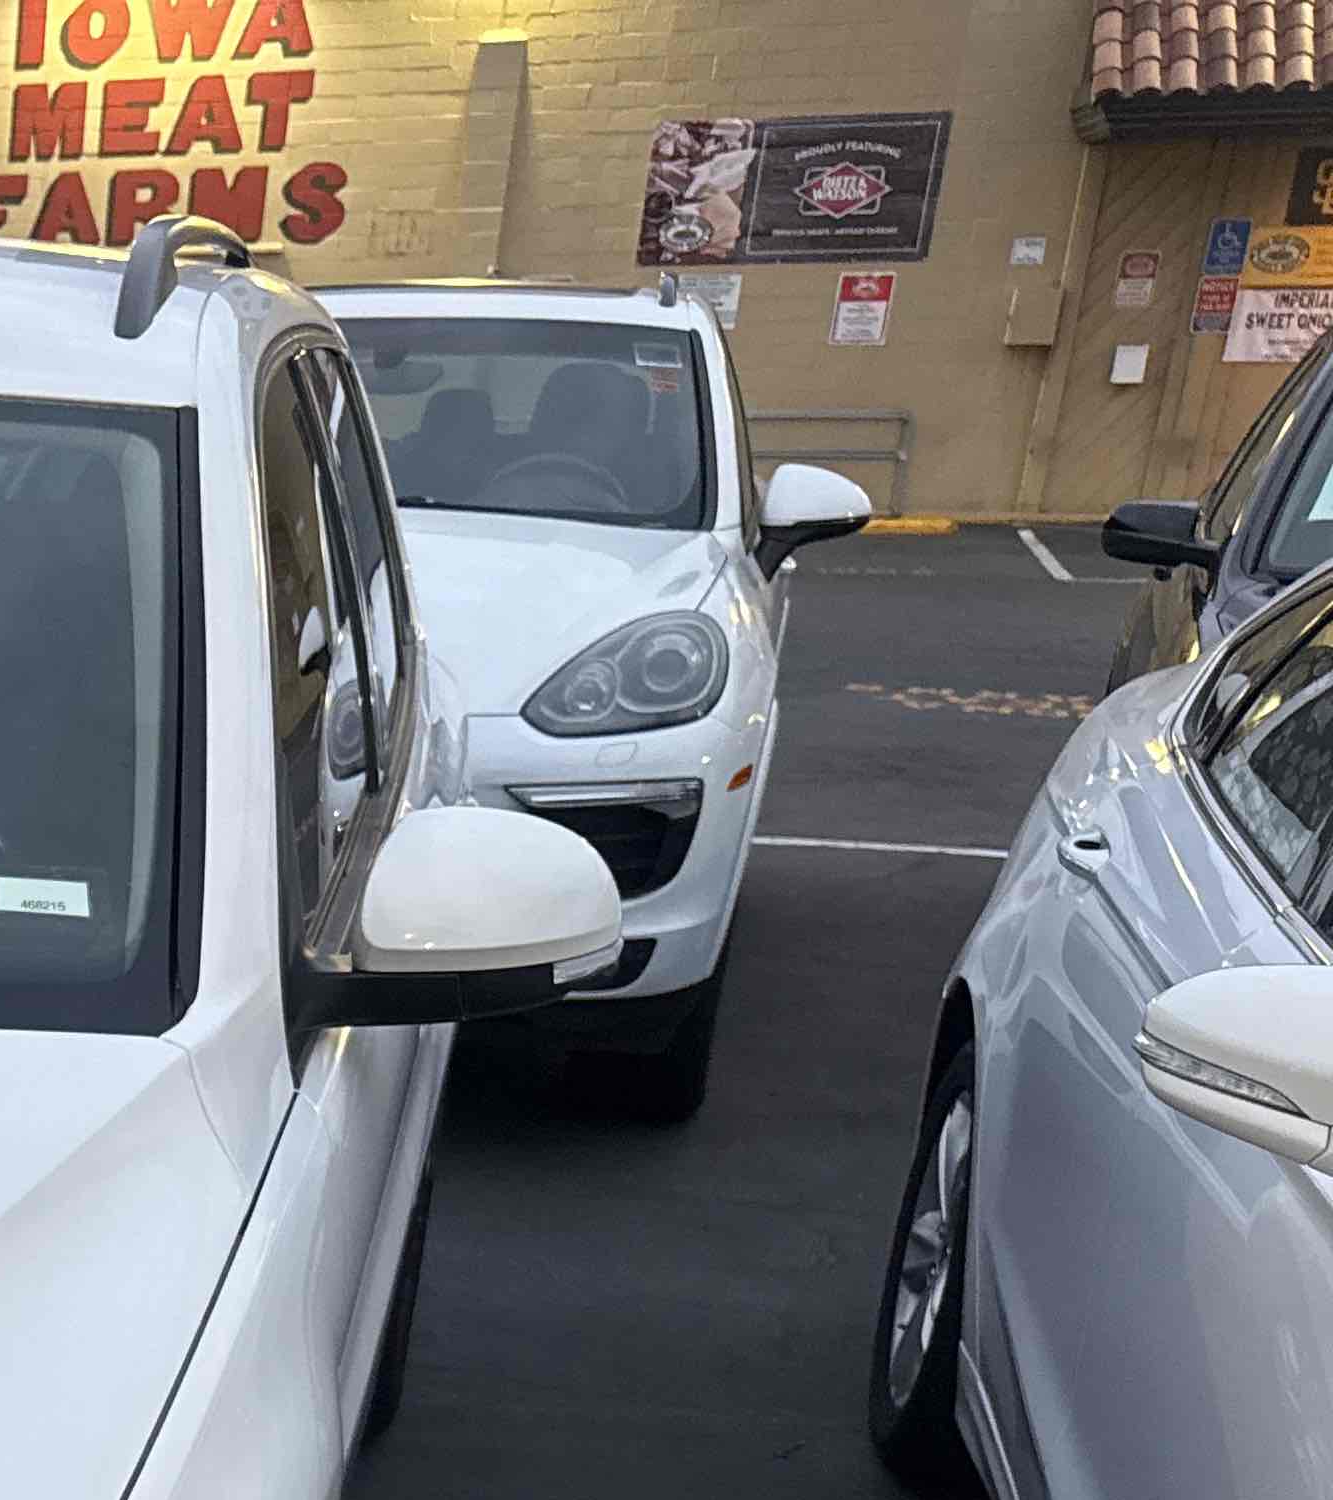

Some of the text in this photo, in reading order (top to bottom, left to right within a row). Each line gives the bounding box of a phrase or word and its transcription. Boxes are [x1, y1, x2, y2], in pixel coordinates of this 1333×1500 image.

[14, 0, 315, 70] IOWA
[8, 70, 316, 162] MEAT
[794, 139, 902, 161] PROUDLY FEATURING
[1244, 312, 1295, 329] SWEET
[20, 898, 67, 912] 468215
